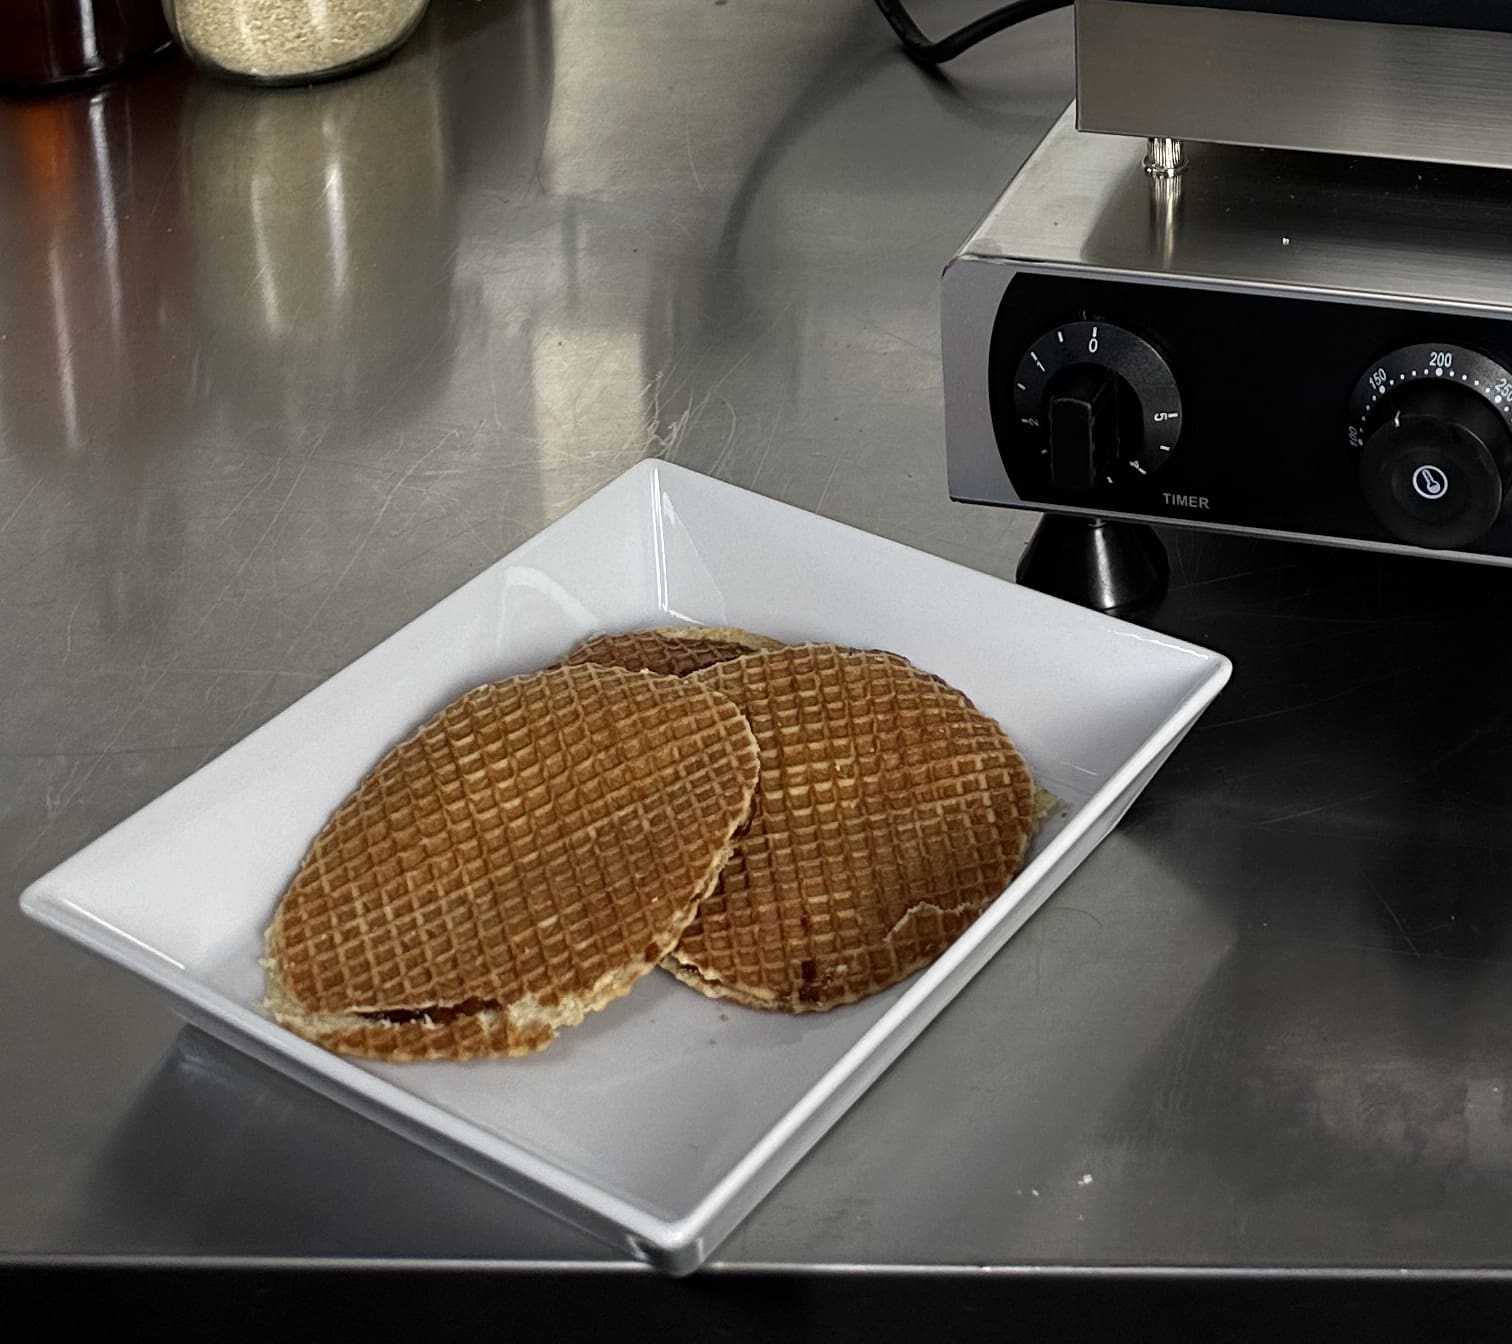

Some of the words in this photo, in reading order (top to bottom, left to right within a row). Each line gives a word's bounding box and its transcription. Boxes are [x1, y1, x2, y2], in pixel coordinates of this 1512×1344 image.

[1088, 338, 1098, 353] 0
[1429, 352, 1452, 367] 200
[1369, 368, 1387, 389] 150
[1154, 412, 1168, 422] 5
[1162, 492, 1210, 510] TIMER
